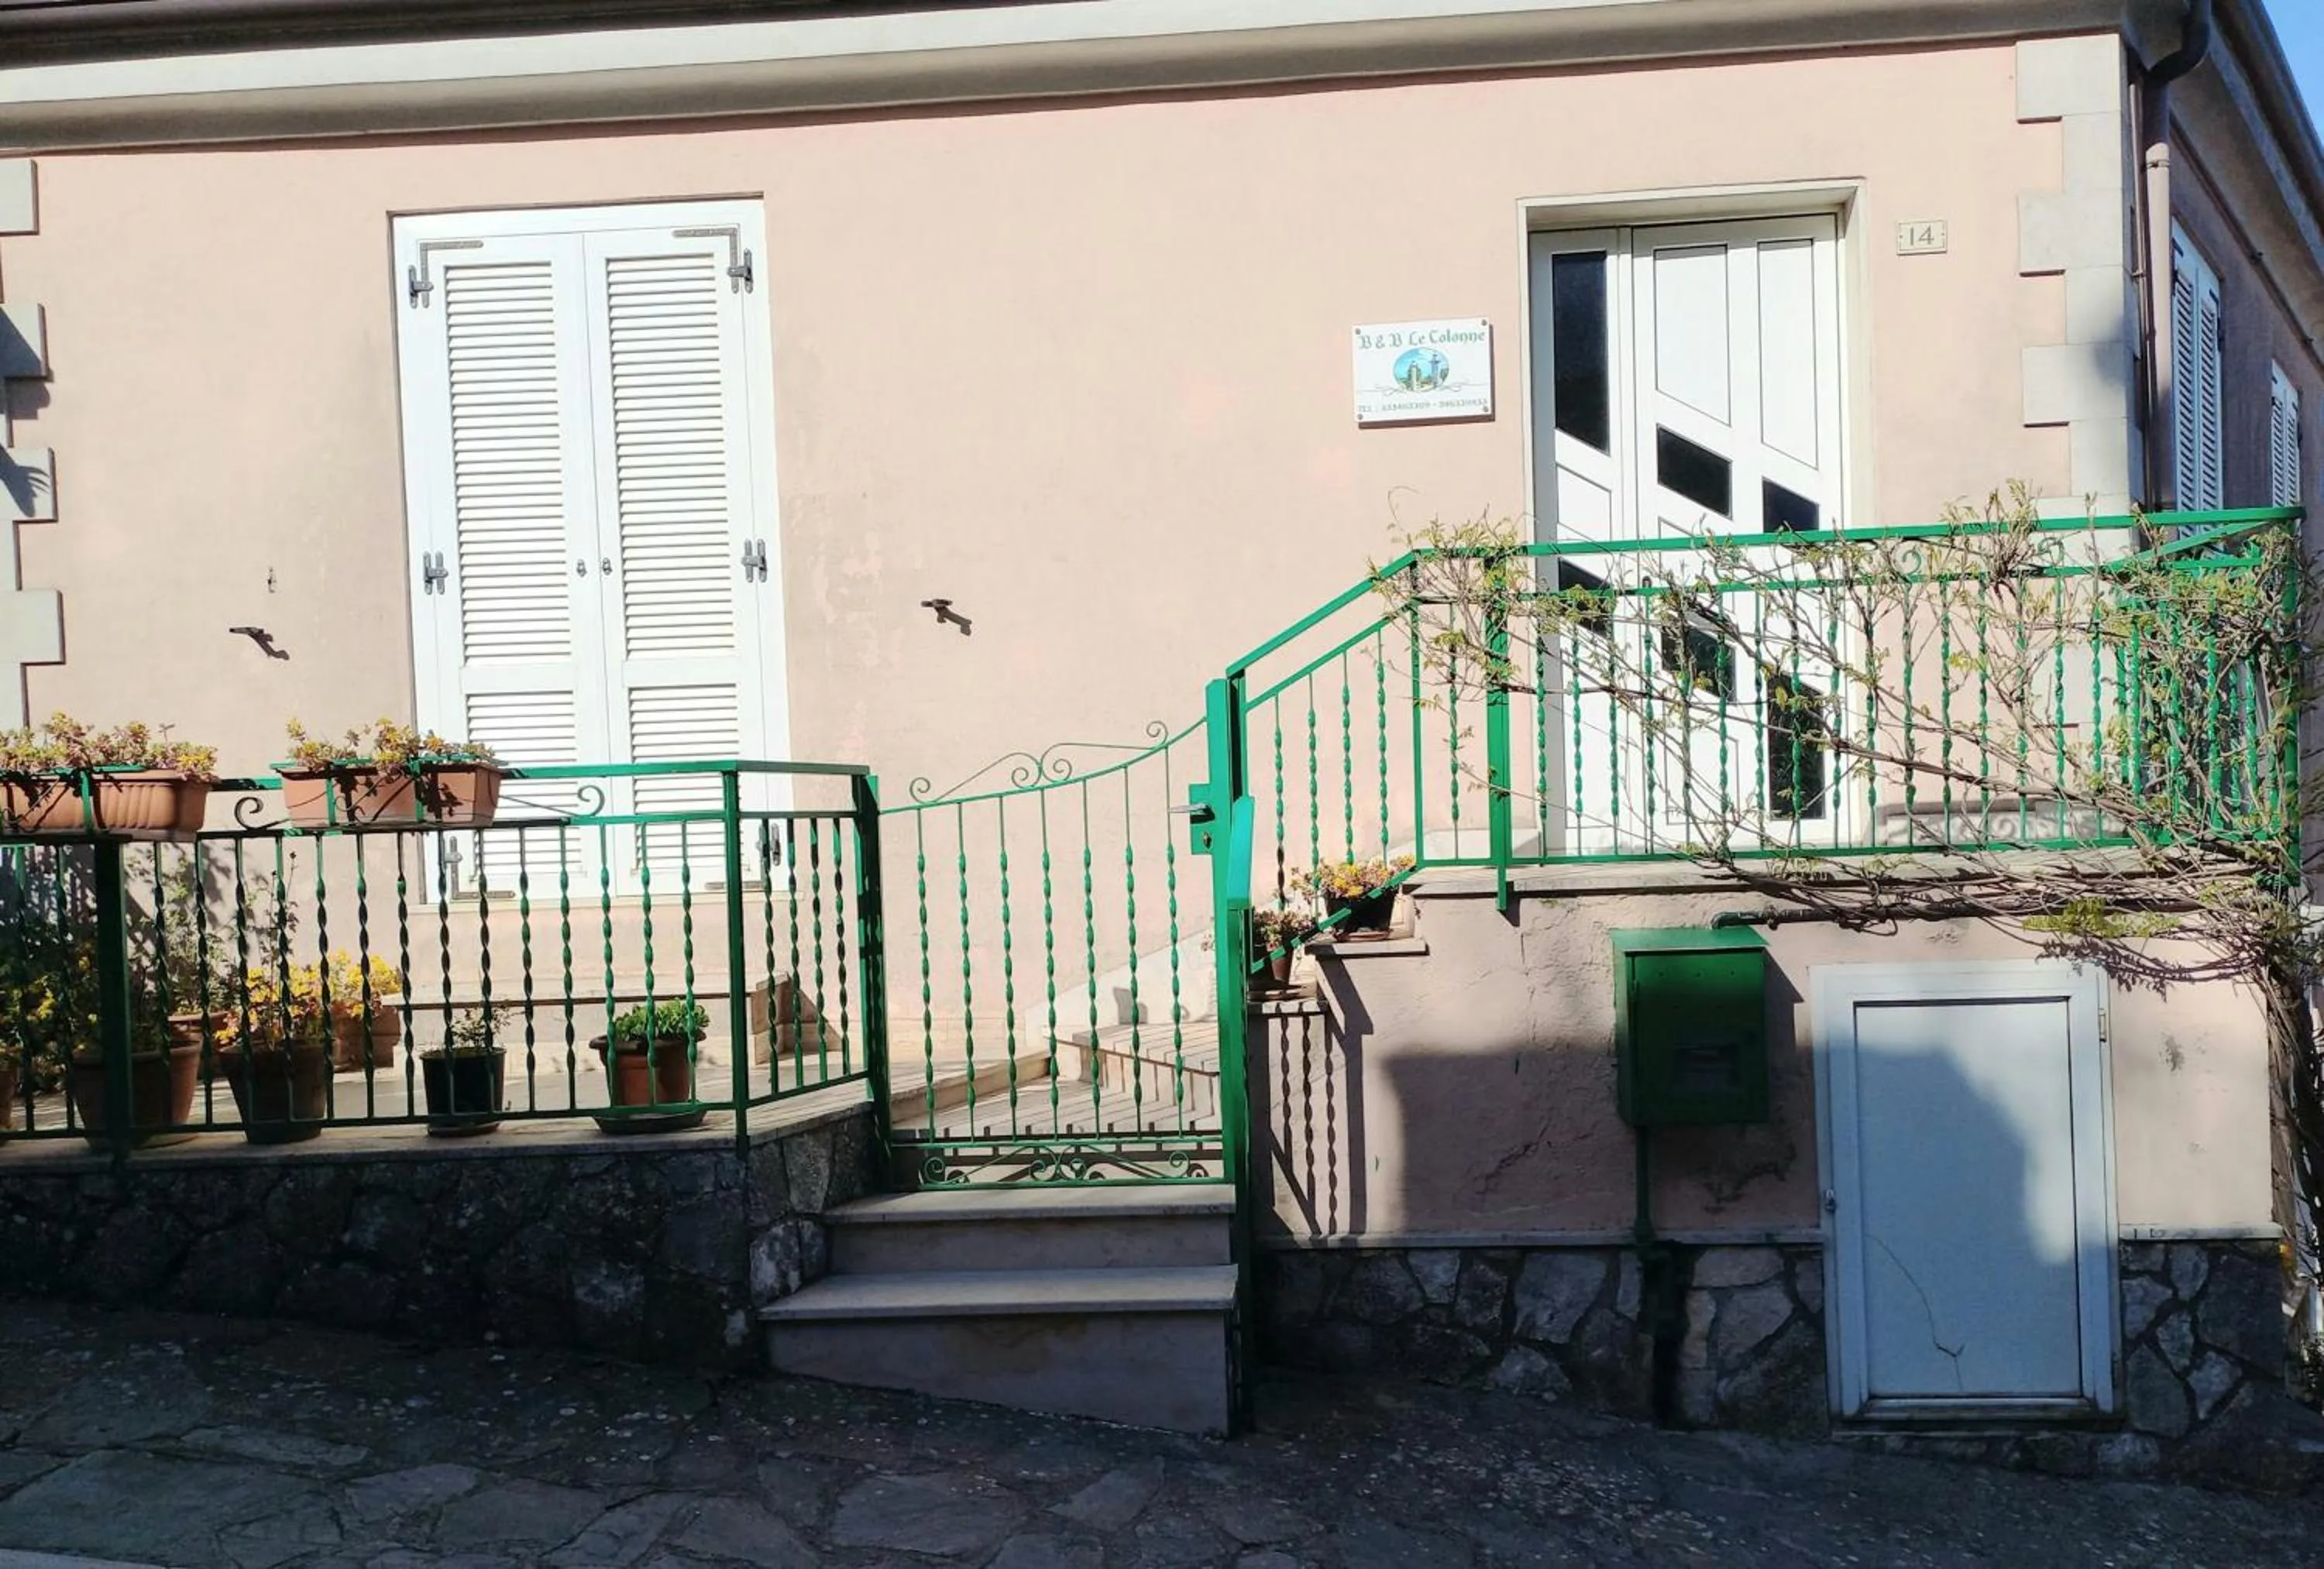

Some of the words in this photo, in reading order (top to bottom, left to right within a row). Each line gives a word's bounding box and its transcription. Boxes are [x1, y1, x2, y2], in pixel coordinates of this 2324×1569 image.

[1910, 225, 1934, 246] 14
[1358, 335, 1372, 349] B
[1389, 332, 1403, 348] B
[1408, 331, 1425, 346] Le
[1428, 328, 1486, 345] Colonne
